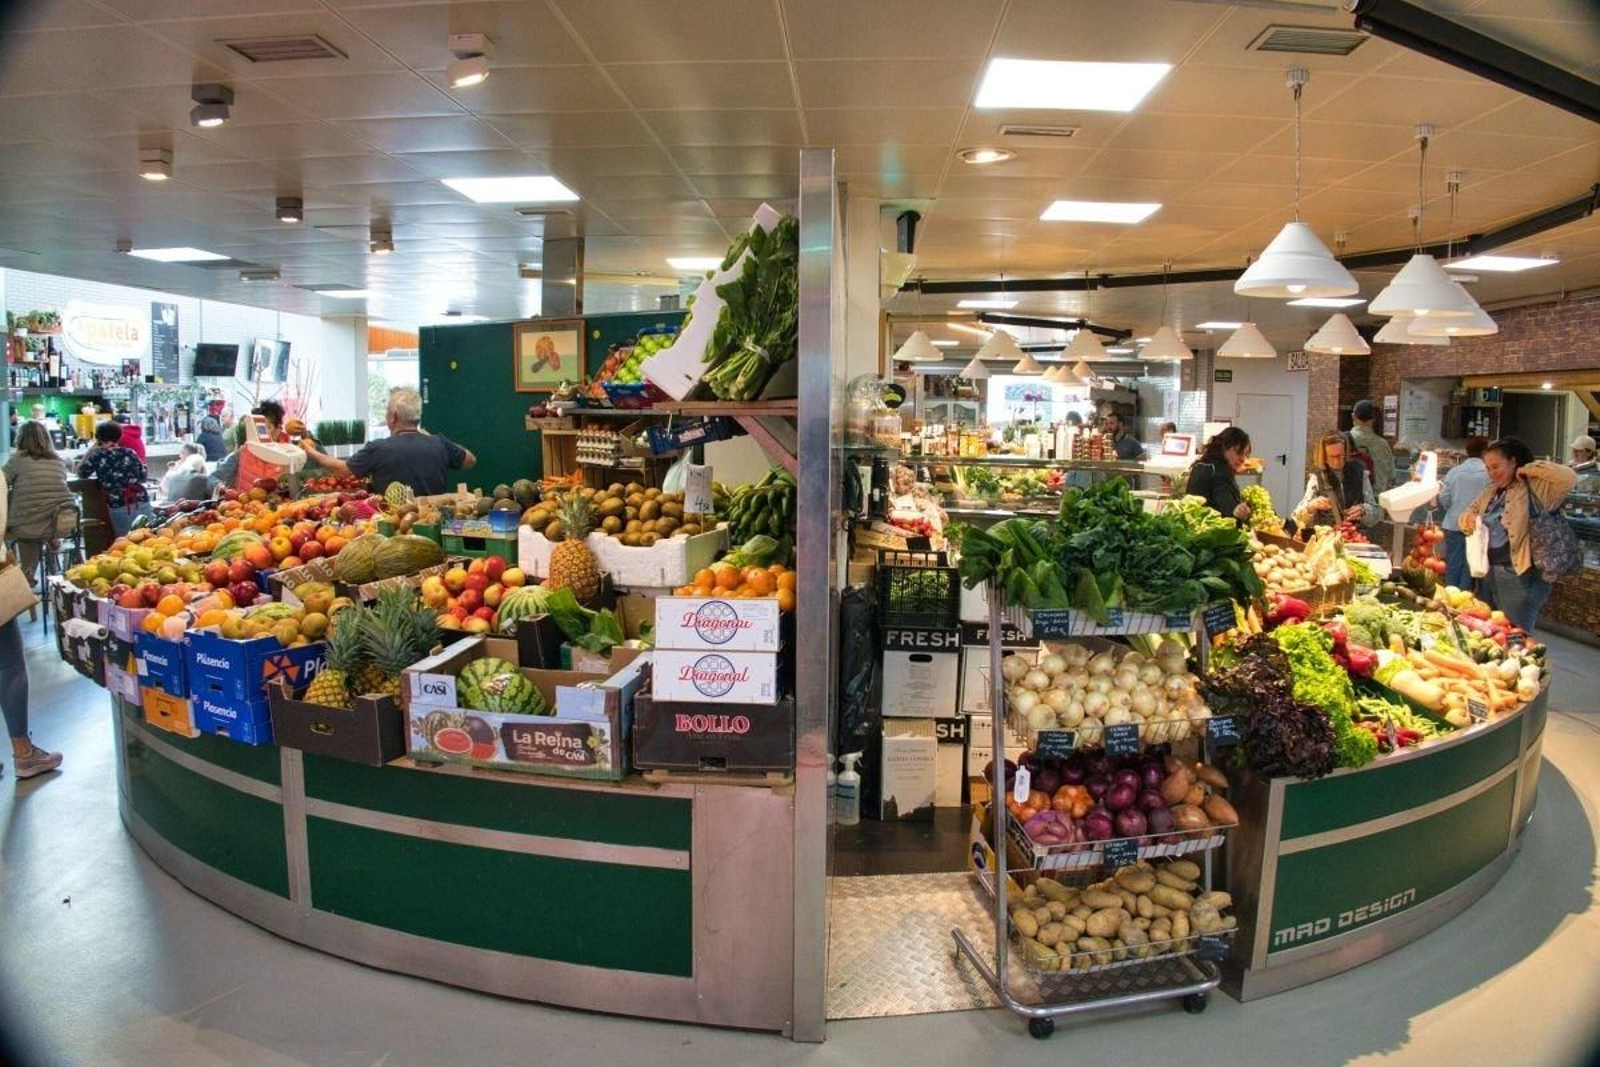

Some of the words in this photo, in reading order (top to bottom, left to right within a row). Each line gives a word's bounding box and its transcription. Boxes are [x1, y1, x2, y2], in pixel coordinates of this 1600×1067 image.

[886, 630, 960, 647] FRESH
[203, 700, 237, 719] Plasencia
[675, 714, 750, 734] BOLLO
[512, 729, 532, 745] La
[535, 731, 583, 750] Reina
[552, 746, 565, 756] de
[1273, 917, 1331, 946] MAD
